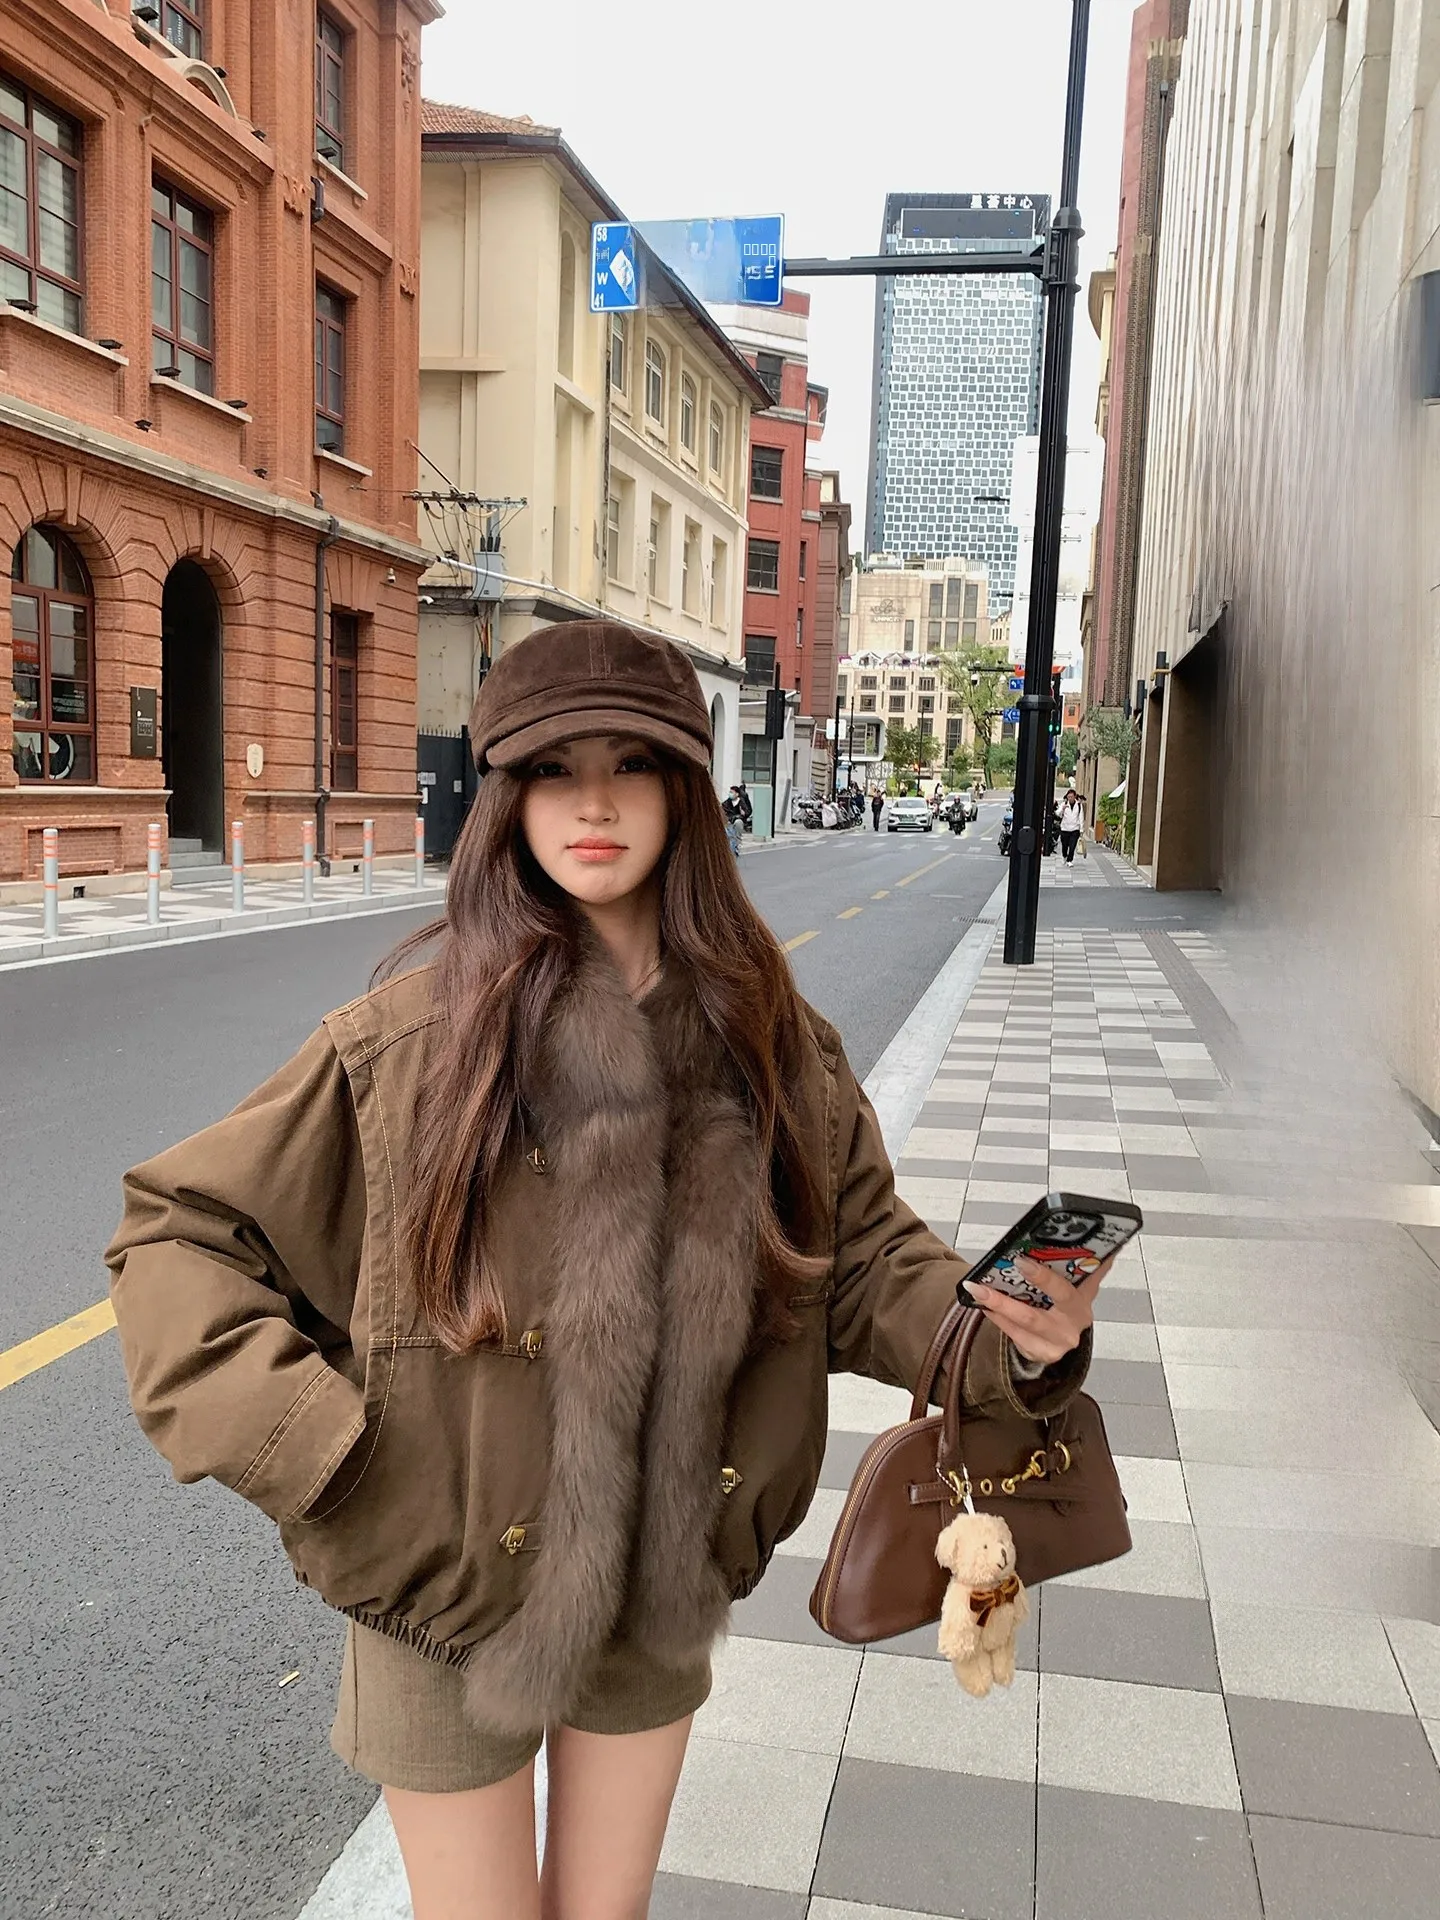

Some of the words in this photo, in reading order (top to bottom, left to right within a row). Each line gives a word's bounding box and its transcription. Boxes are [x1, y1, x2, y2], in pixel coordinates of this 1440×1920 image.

[597, 227, 607, 241] 58
[597, 272, 608, 285] W
[594, 292, 604, 308] 41
